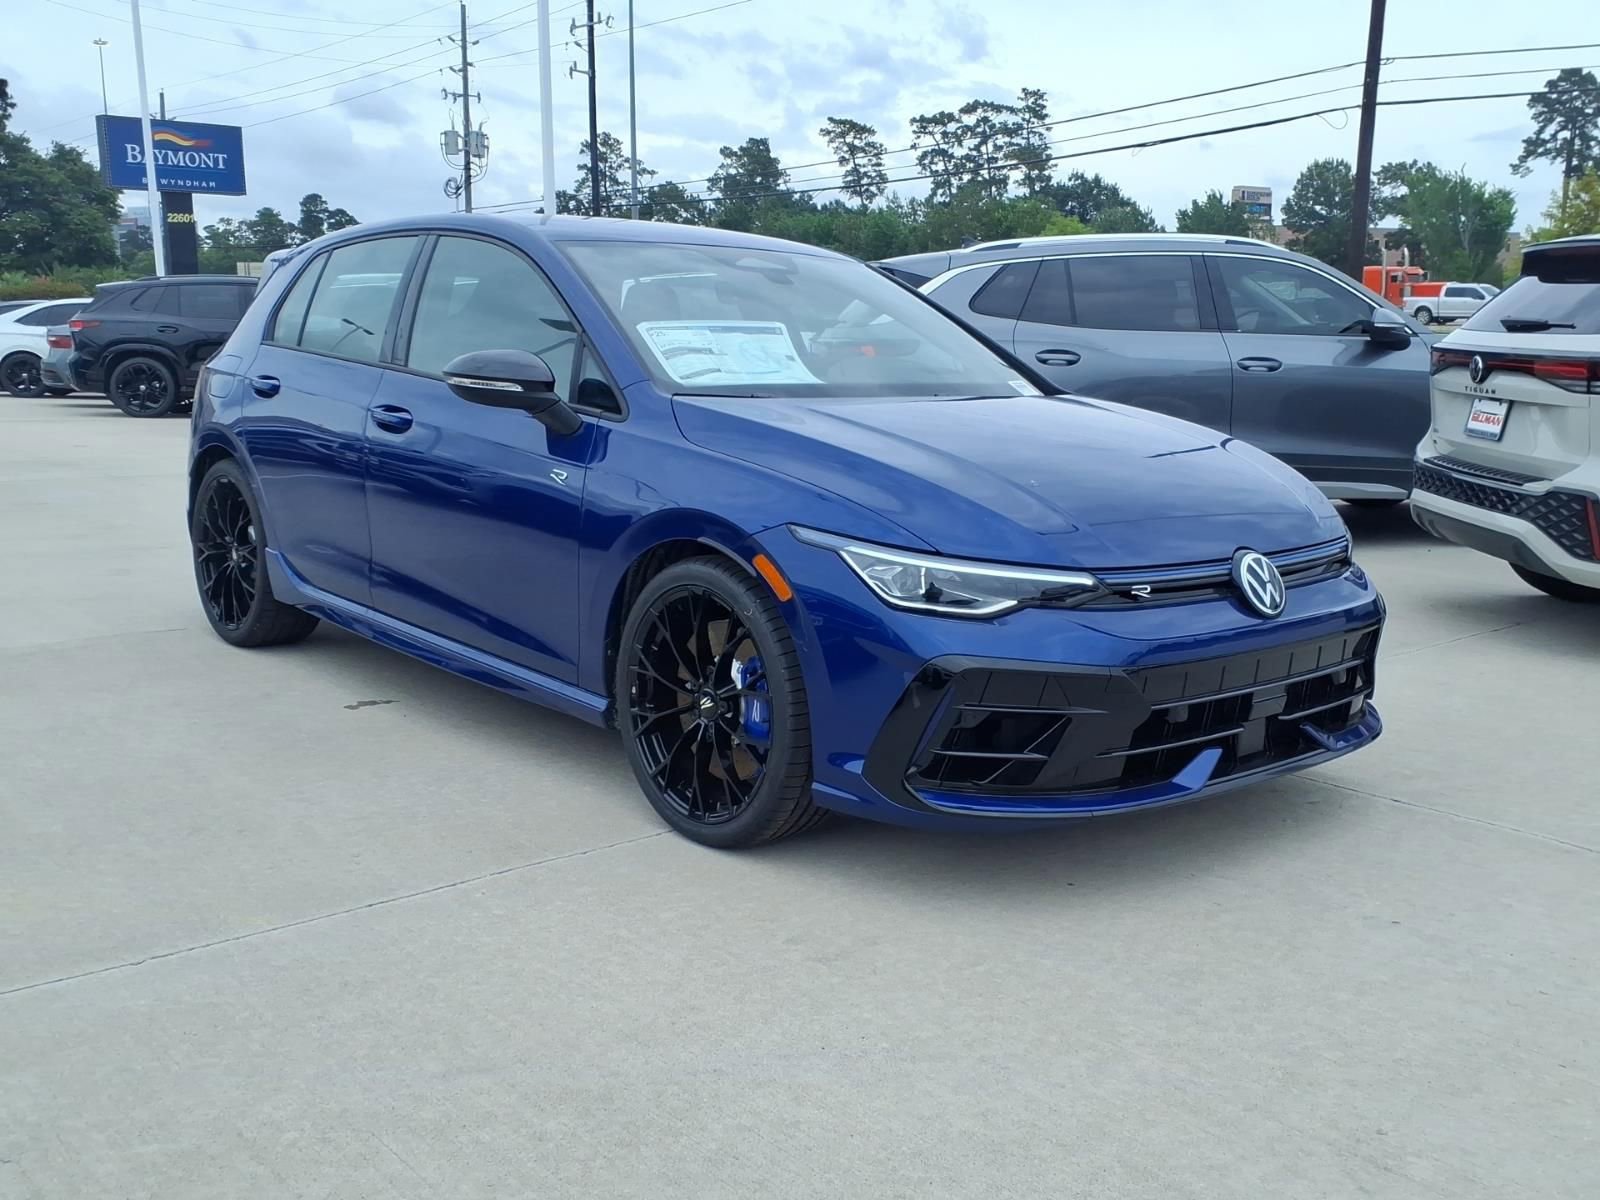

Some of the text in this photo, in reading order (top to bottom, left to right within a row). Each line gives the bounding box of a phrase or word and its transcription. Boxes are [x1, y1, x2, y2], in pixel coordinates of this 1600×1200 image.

[160, 178, 216, 188] WYNDHAM
[167, 213, 194, 223] 22601
[1464, 385, 1497, 395] TIGUAN
[1471, 412, 1504, 426] GILLMAN
